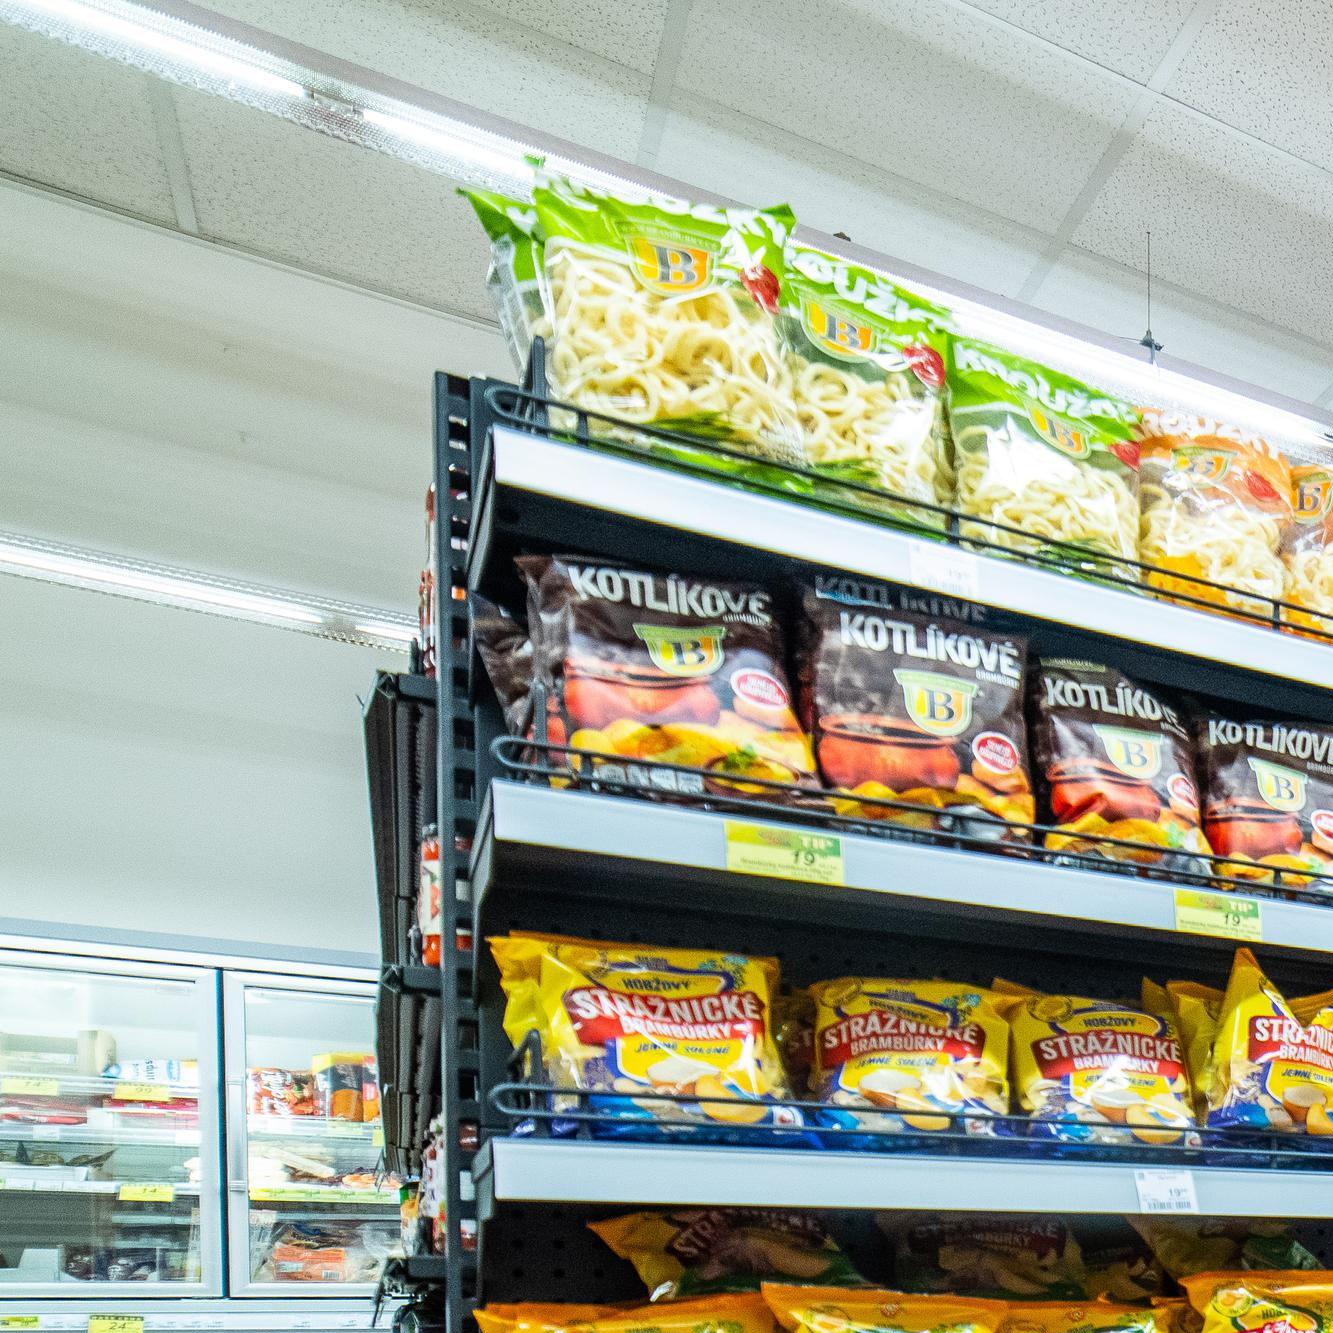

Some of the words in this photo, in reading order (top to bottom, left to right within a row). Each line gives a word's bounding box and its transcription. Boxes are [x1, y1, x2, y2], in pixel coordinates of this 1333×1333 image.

[653, 244, 696, 287] B
[672, 639, 707, 665] B
[840, 611, 1020, 679] KOTLÍKOVÉ
[923, 688, 955, 720] B
[1119, 742, 1148, 767] B
[1272, 775, 1294, 800] B
[1040, 1032, 1181, 1064] STRÁŽNICKÉ
